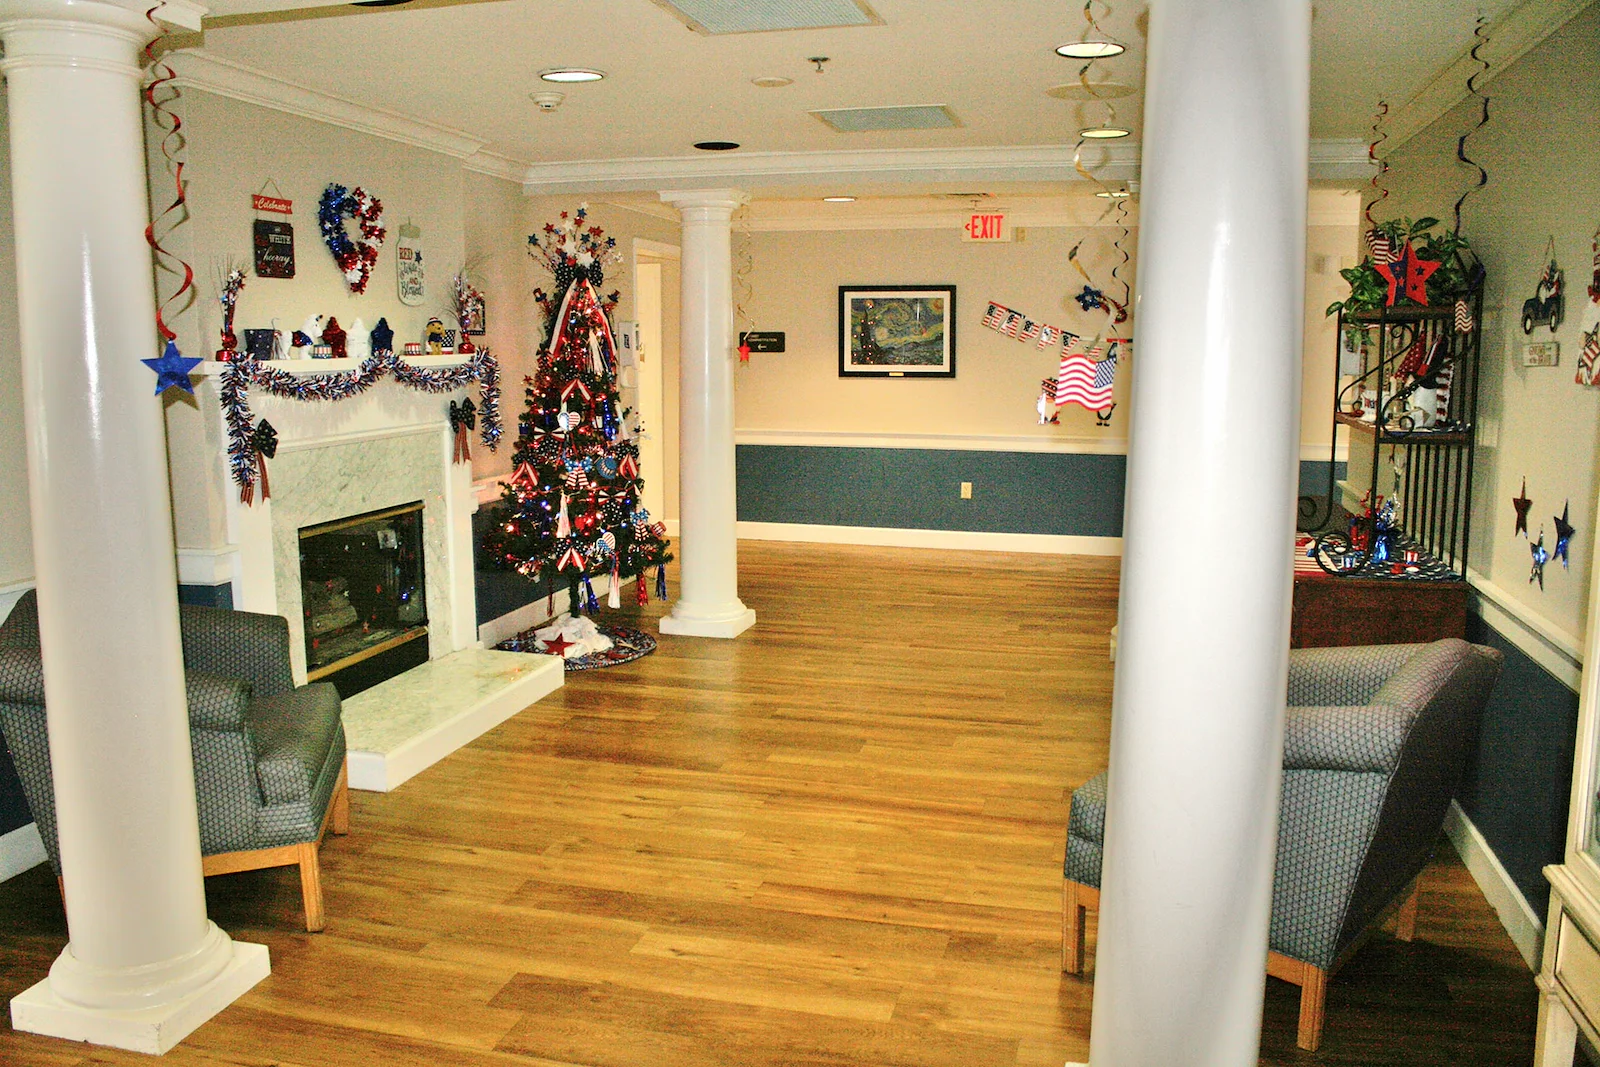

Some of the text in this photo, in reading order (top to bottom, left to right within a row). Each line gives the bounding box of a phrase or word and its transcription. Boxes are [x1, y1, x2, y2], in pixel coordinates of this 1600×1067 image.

[257, 198, 287, 211] Celebrate
[971, 215, 1004, 239] EXIT
[262, 246, 291, 269] hooray
[981, 304, 1079, 358] HAPPY
